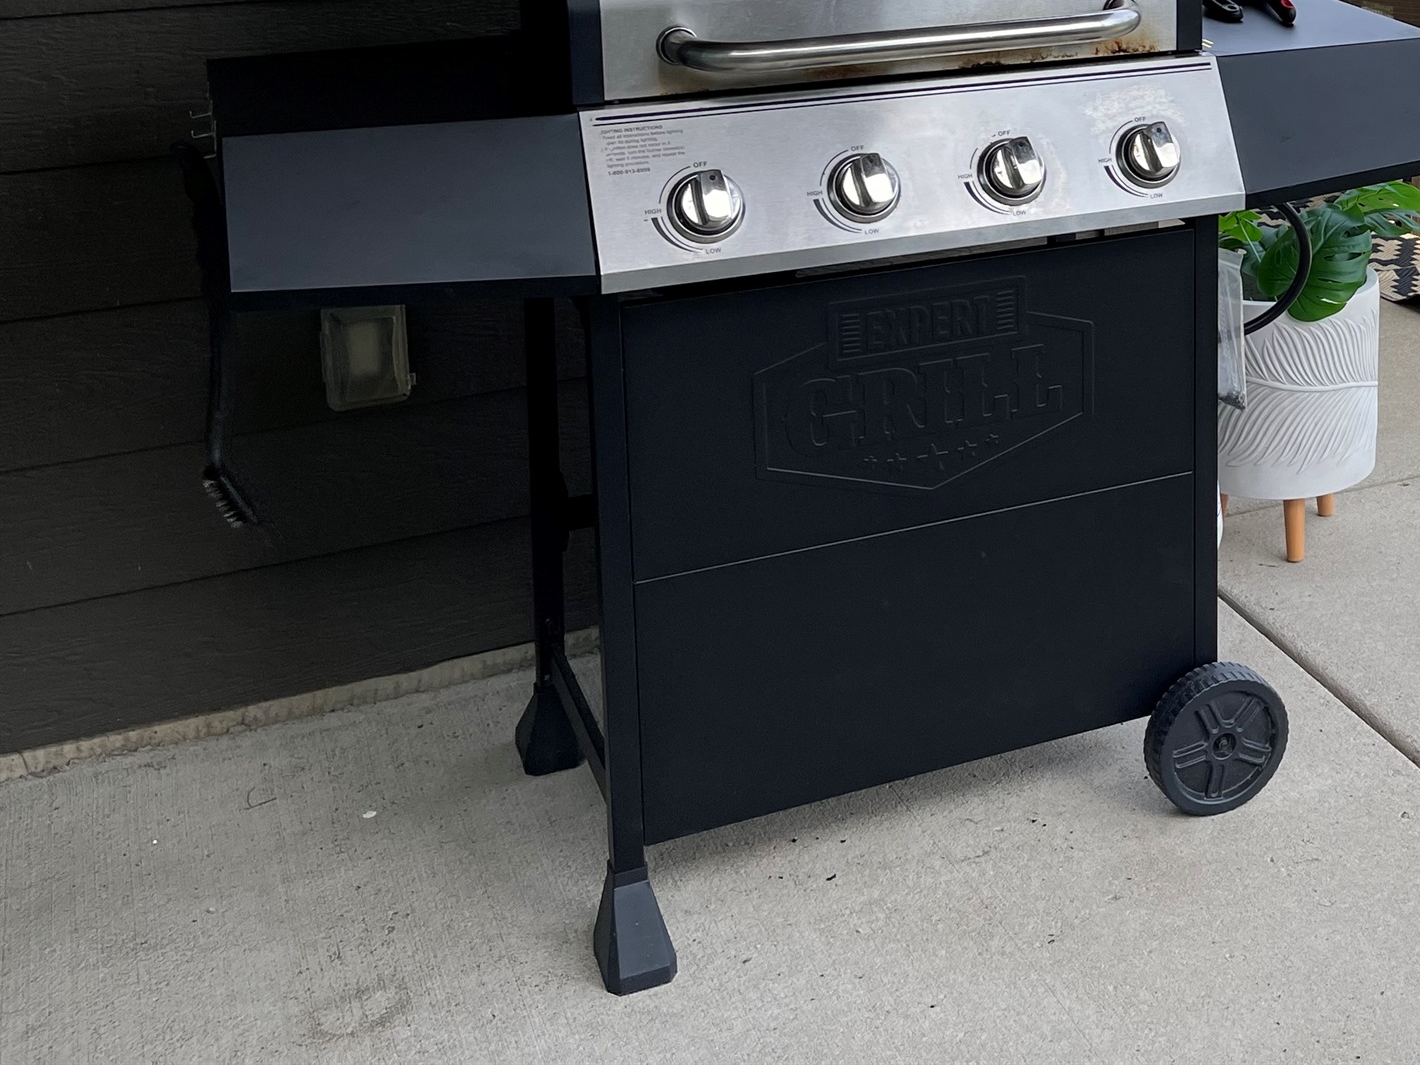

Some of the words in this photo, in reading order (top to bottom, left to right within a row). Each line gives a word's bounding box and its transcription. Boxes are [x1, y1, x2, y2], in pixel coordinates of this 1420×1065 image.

[705, 247, 722, 255] LOW
[865, 294, 991, 350] EXPERT
[783, 343, 1064, 457] GRILL
